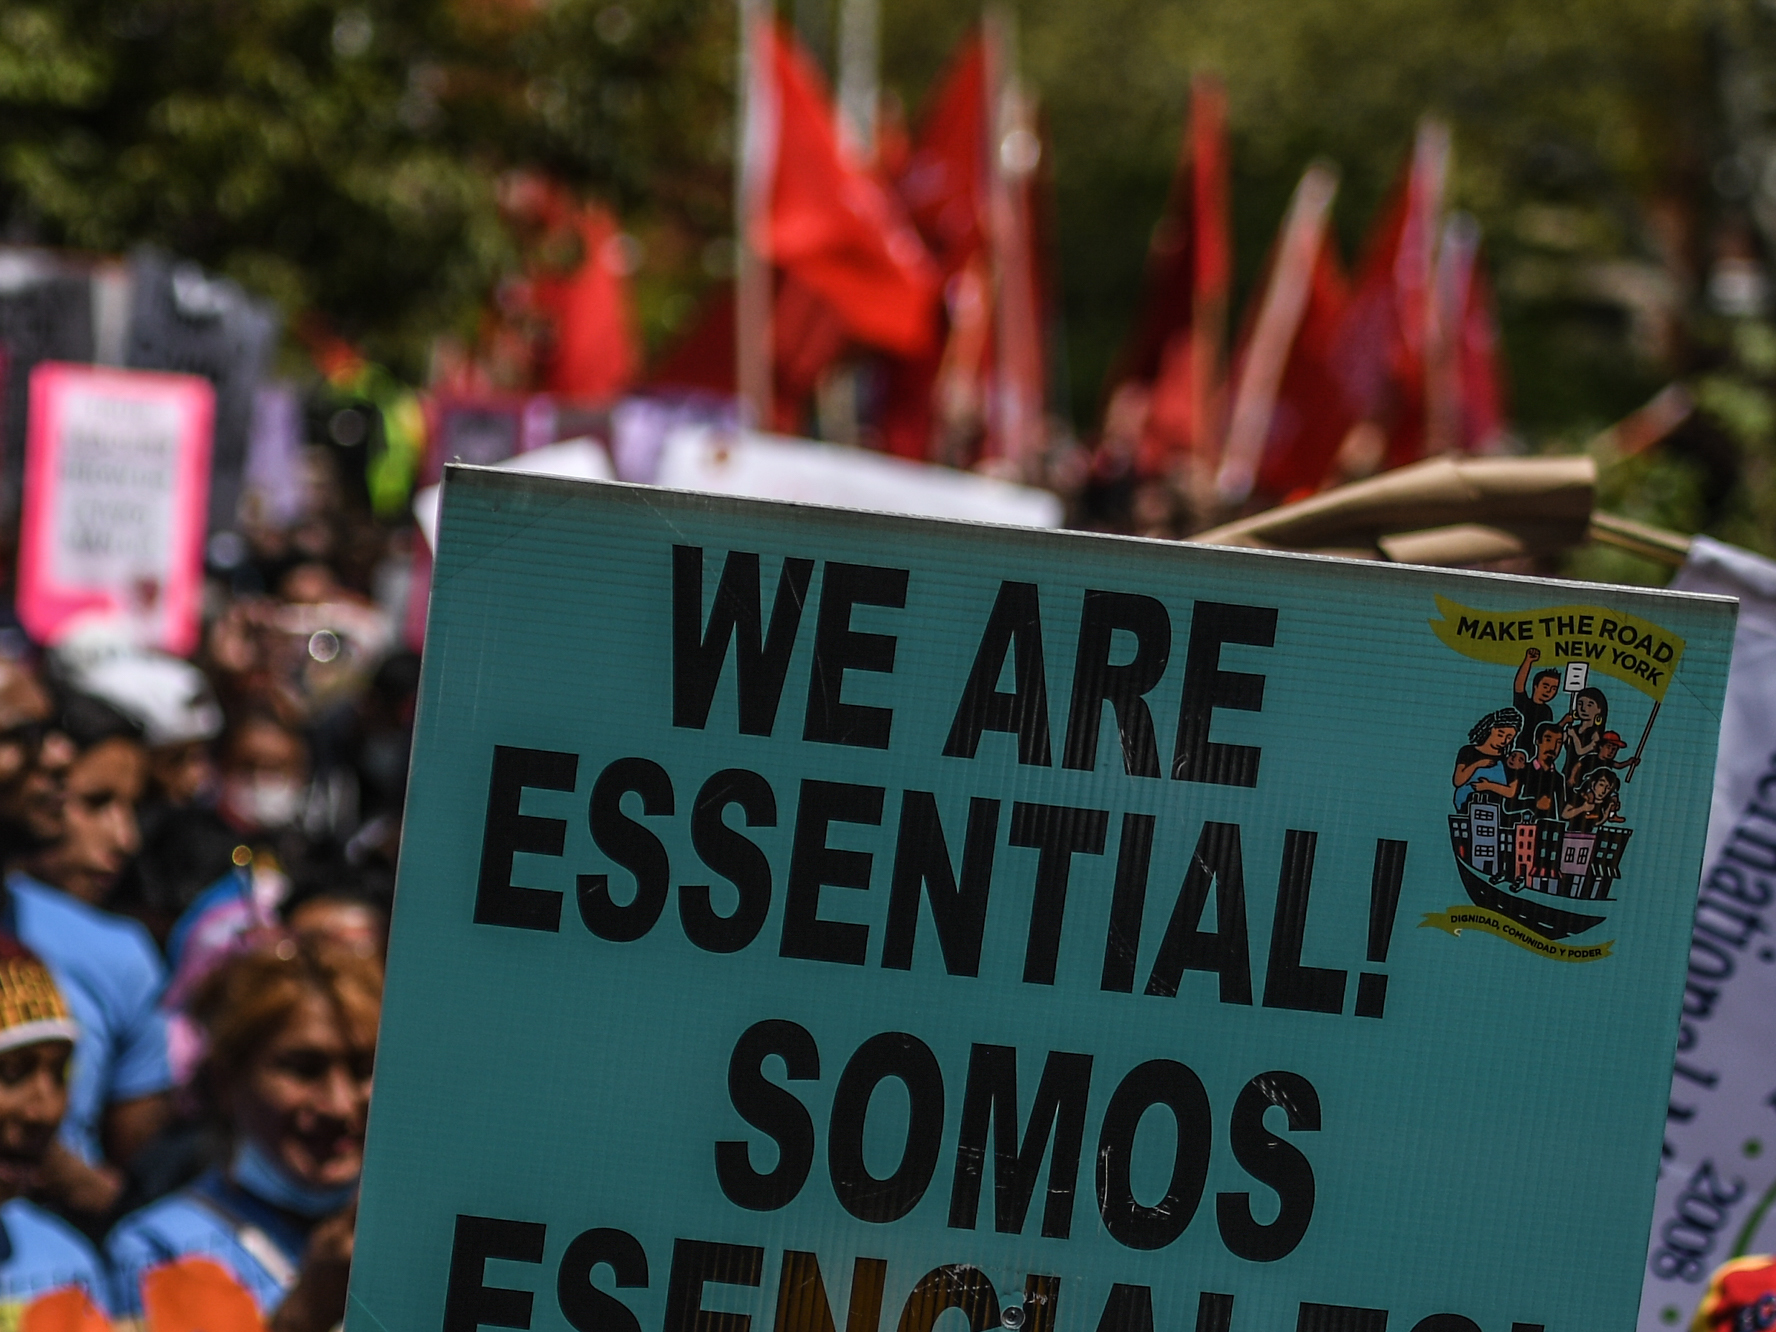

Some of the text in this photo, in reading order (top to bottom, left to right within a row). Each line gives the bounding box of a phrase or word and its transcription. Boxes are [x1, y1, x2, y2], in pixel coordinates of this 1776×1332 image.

[672, 545, 1279, 789] WE ARE
[1456, 615, 1674, 664] MAKE THE ROAD
[1555, 641, 1665, 687] NEW YORK
[473, 745, 1408, 1019] ESSENTIAL!
[1450, 914, 1602, 958] DIGNIDAD, COMUNIDAD Y PODER
[714, 1019, 1321, 1263] SOMOS
[1649, 1156, 1746, 1286] 2008
